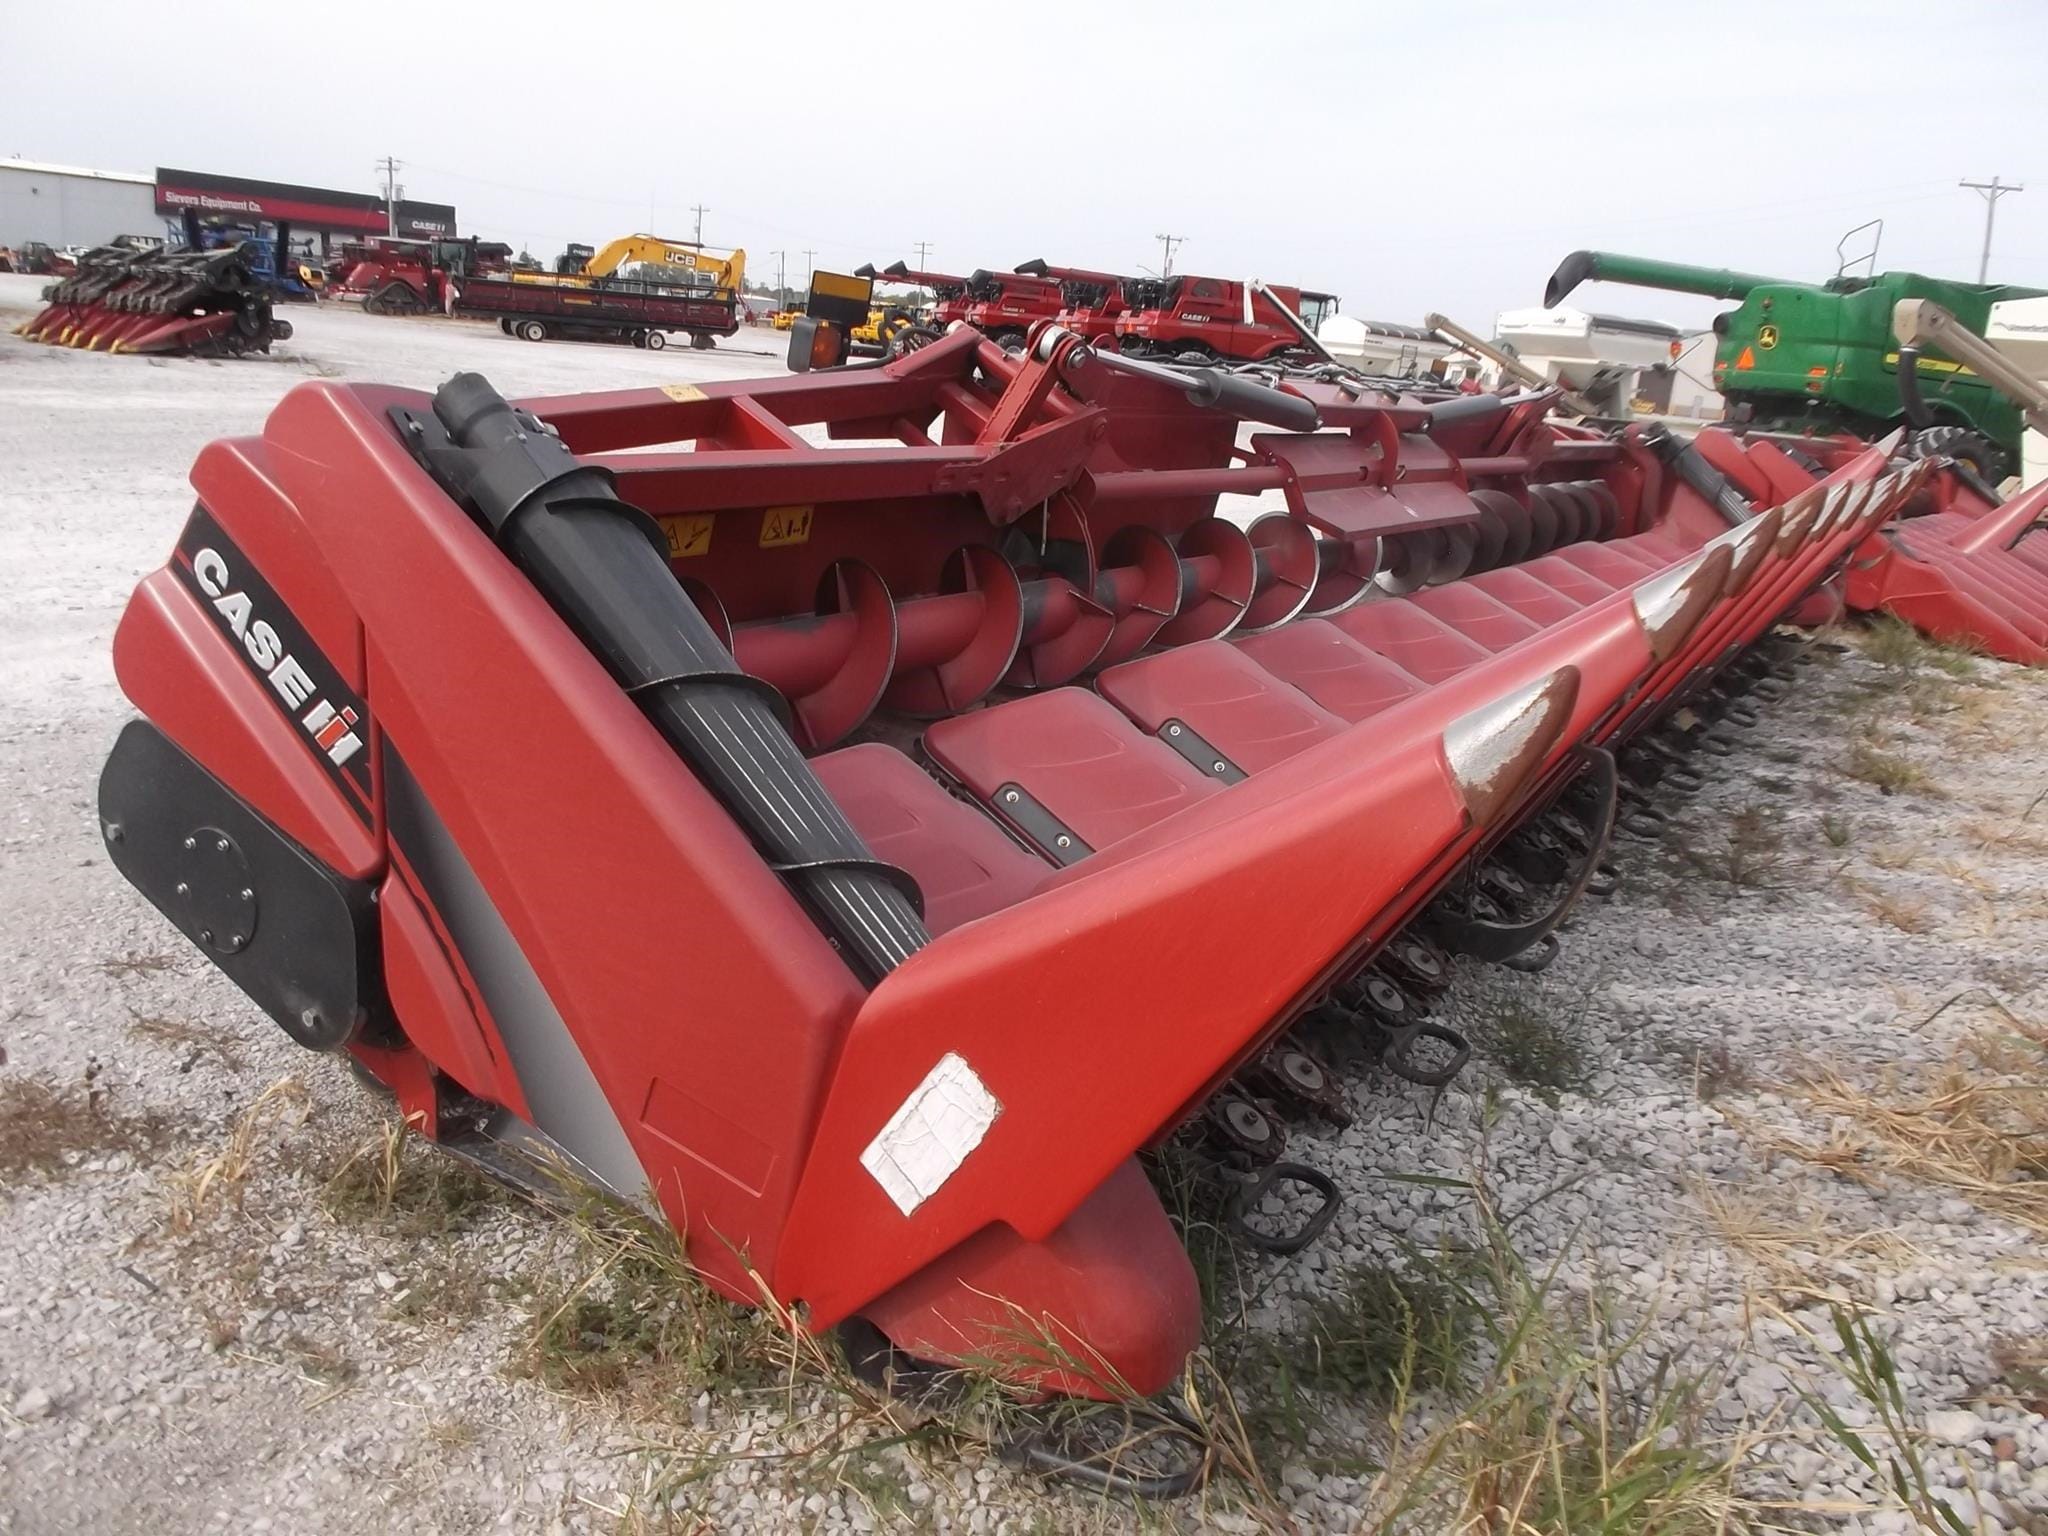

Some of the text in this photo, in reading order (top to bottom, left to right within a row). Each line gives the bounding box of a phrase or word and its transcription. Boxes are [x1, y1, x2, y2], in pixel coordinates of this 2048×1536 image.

[200, 195, 248, 211] Equipment
[411, 220, 436, 231] CASE
[665, 251, 696, 266] JCB
[1181, 313, 1202, 321] CASE
[194, 547, 317, 712] CASE
